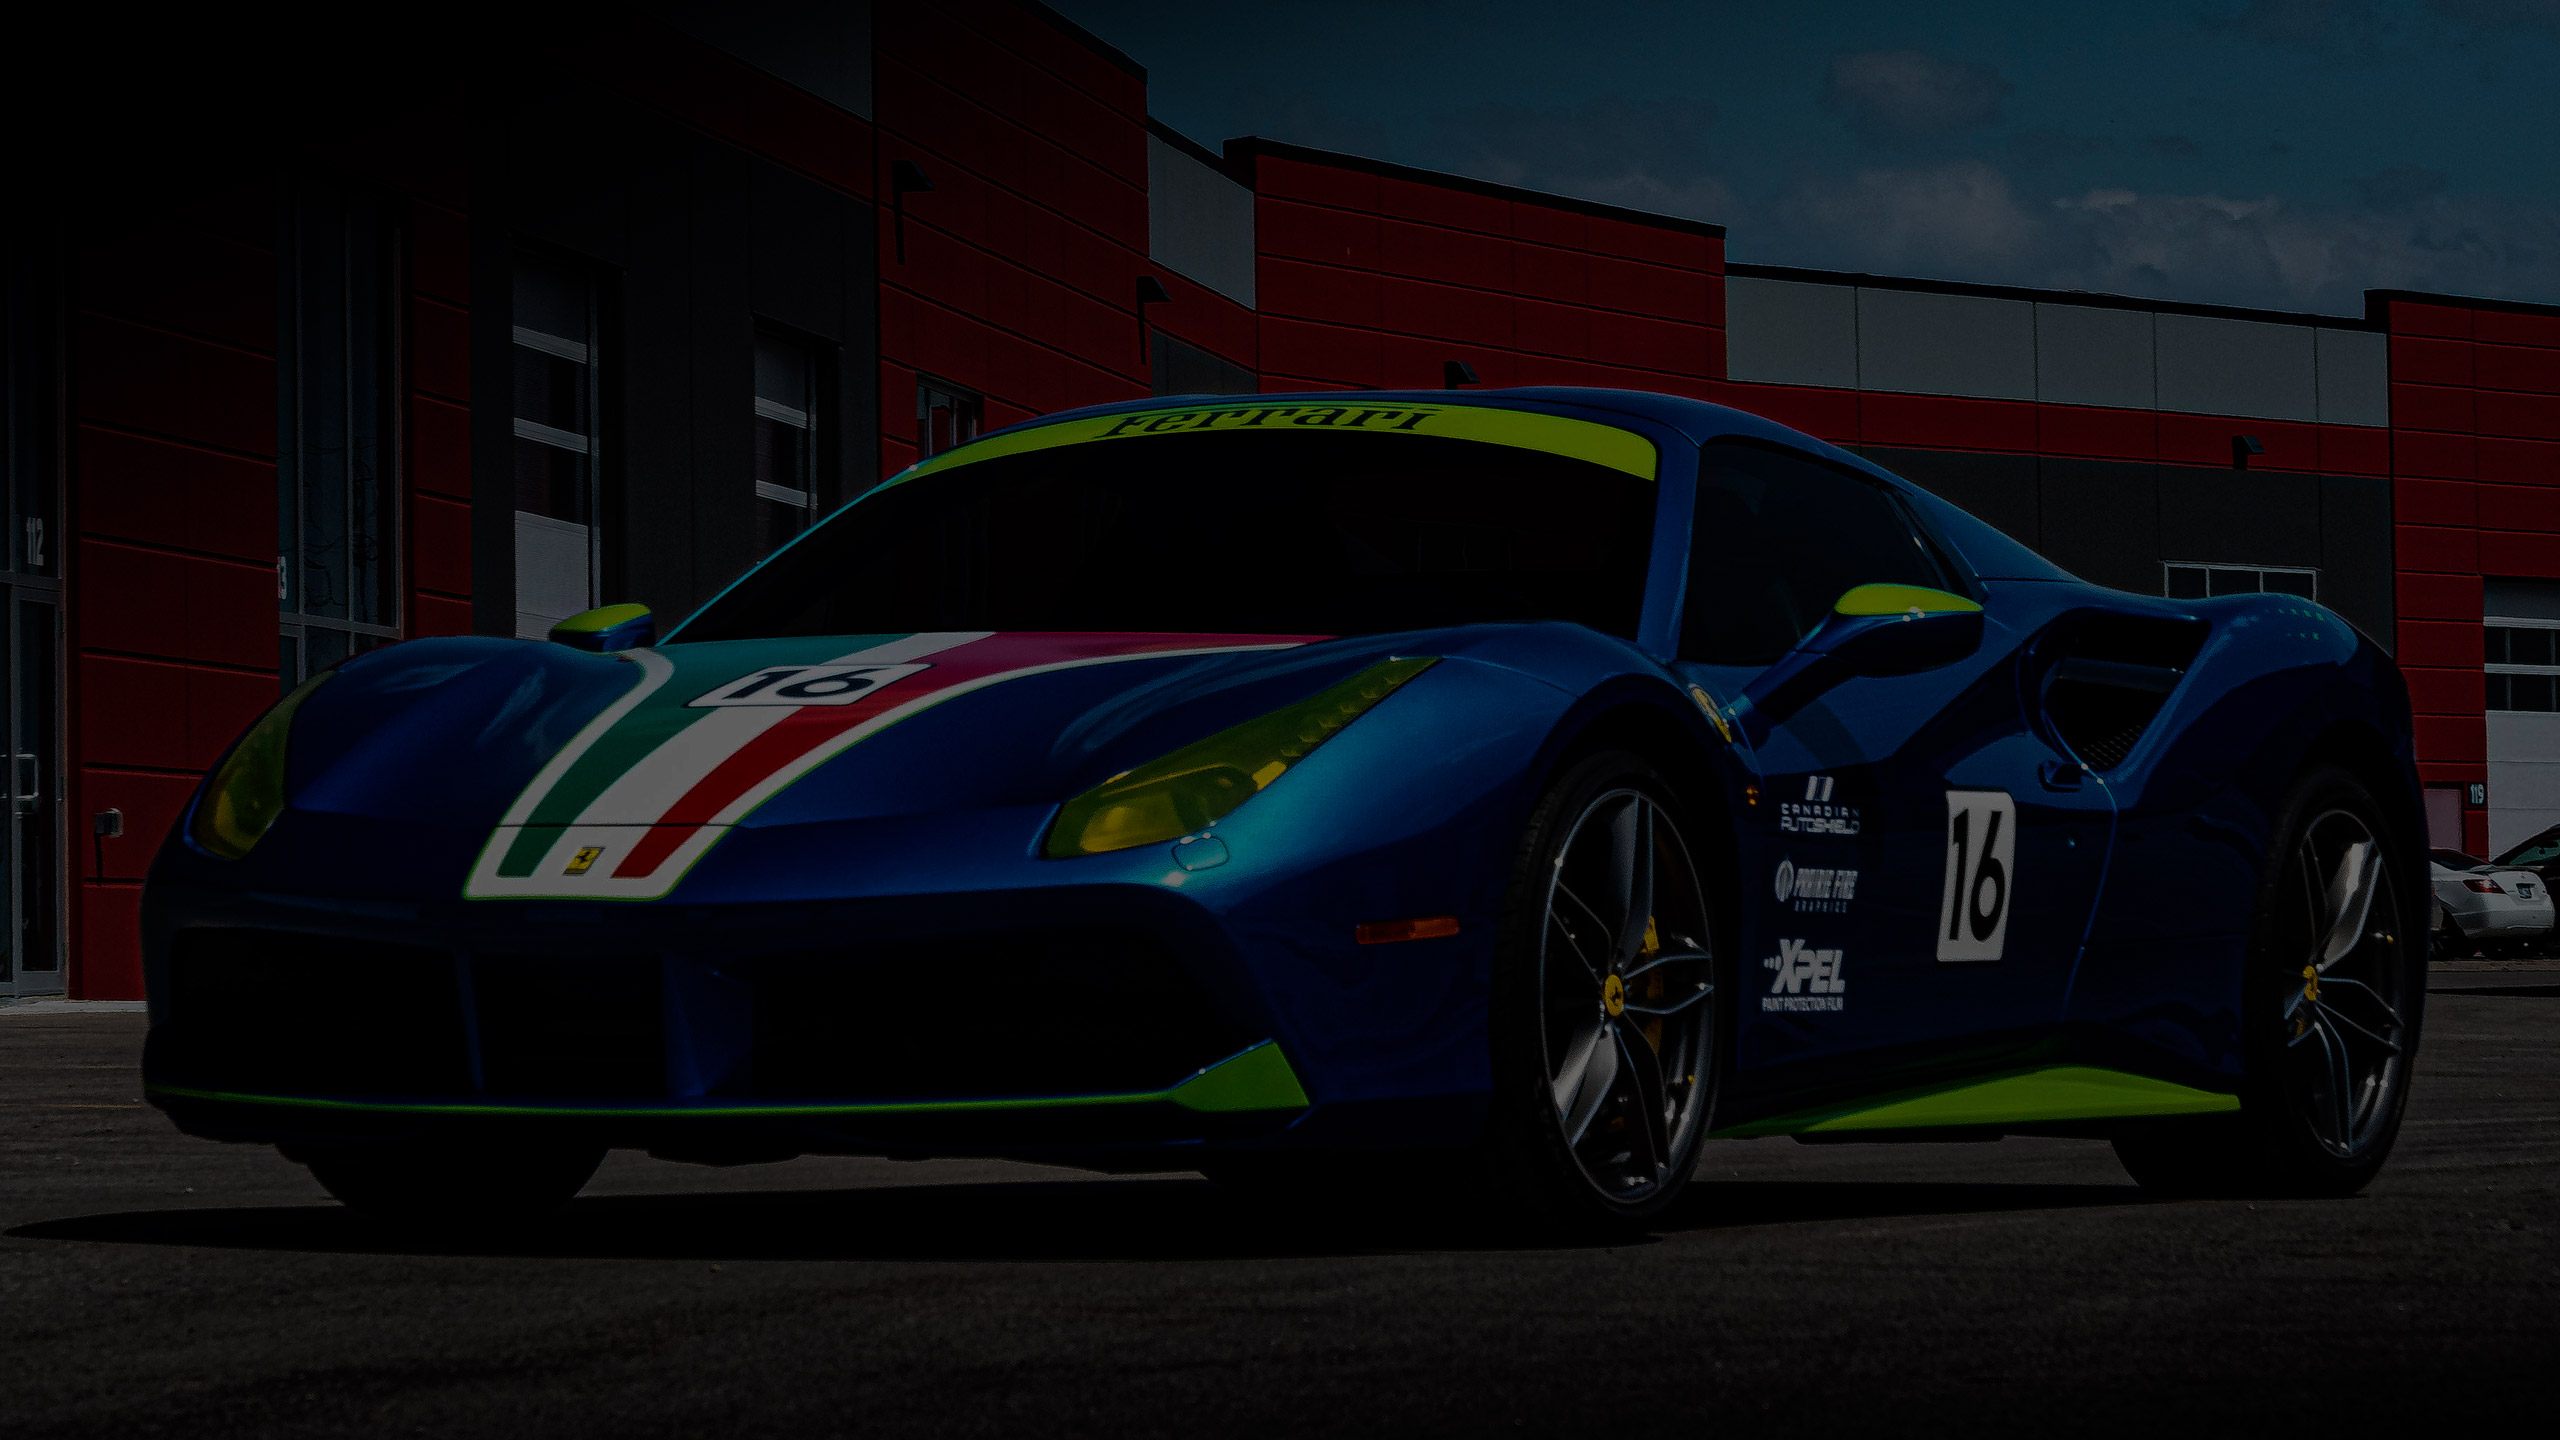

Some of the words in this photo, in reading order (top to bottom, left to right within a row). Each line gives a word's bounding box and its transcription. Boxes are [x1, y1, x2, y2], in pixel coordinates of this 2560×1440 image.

[1094, 402, 1442, 438] Ferrari
[26, 516, 45, 567] 112
[721, 668, 890, 700] 16
[1780, 802, 1861, 818] CANADIAN
[2470, 783, 2486, 805] 119
[1949, 808, 2006, 941] 16
[1771, 938, 1846, 994] XPEL
